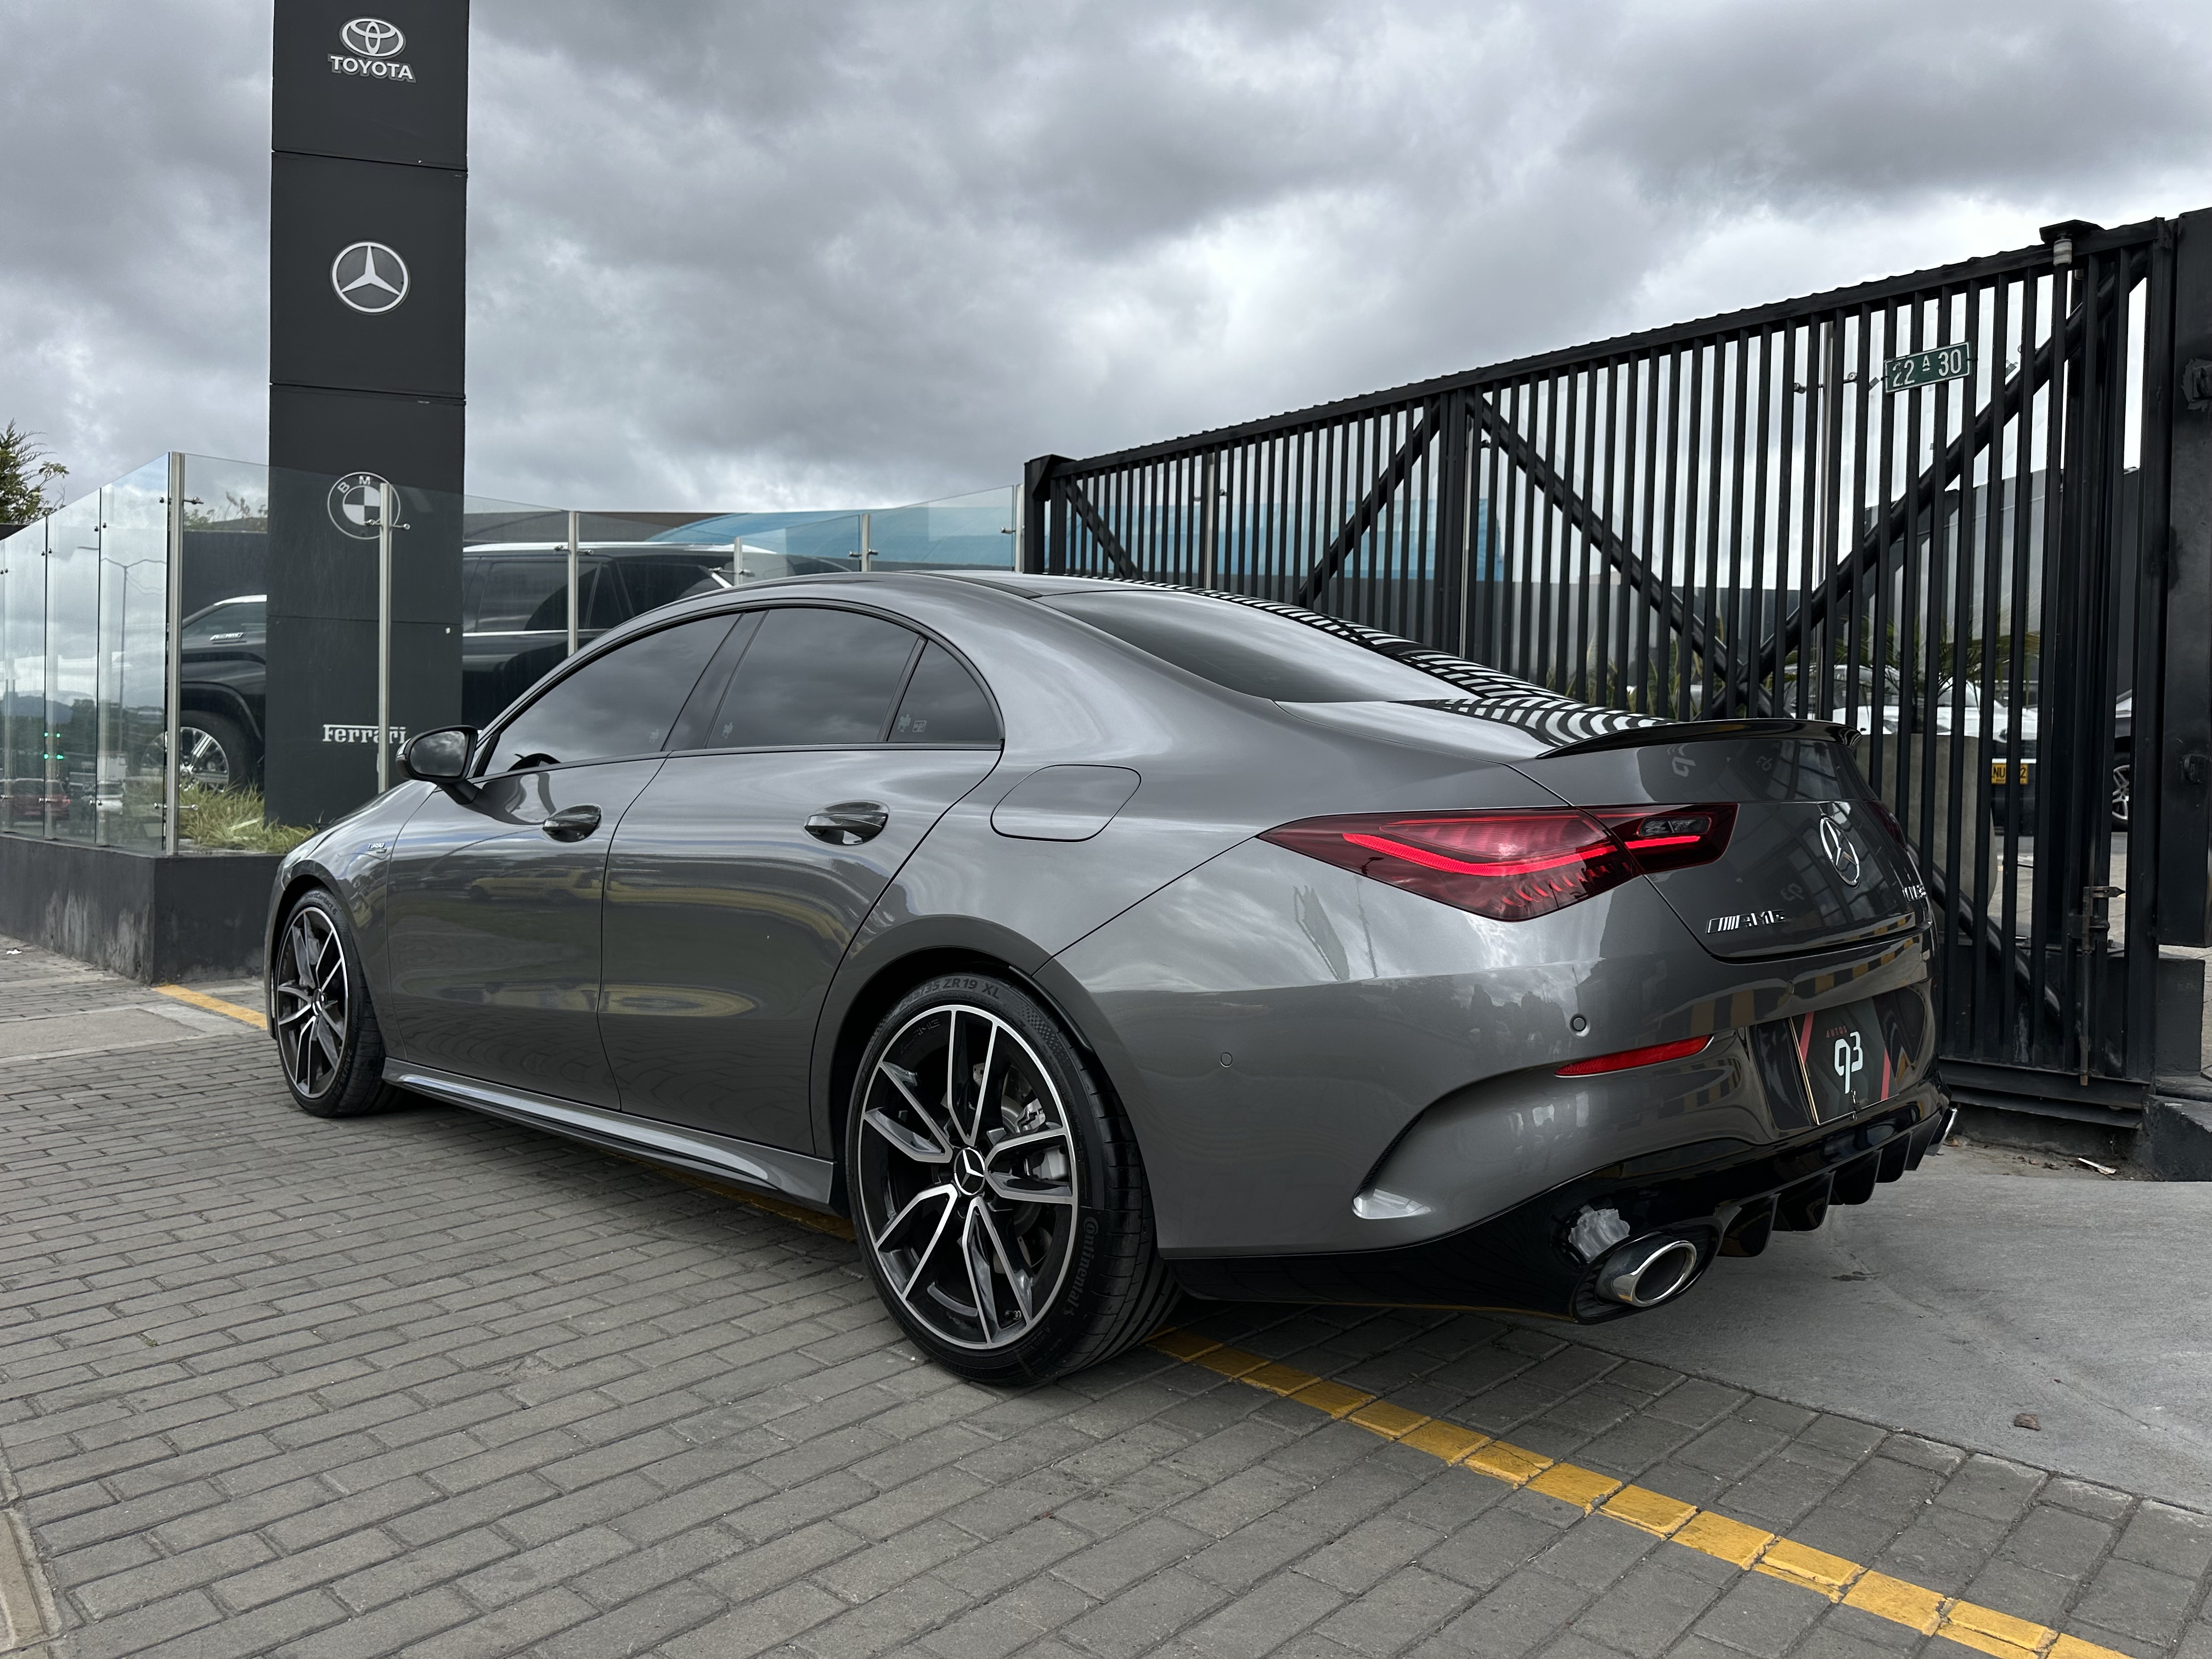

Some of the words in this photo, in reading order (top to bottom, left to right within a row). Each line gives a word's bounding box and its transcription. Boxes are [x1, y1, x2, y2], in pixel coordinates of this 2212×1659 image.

[330, 55, 413, 80] TOYOTA
[1893, 359, 1915, 387] 22
[1938, 349, 1962, 377] 30
[943, 978, 962, 988] ZR
[963, 979, 978, 989] 19
[982, 983, 1000, 999] XL
[1826, 1025, 1848, 1038] AUTOS
[1067, 1216, 1099, 1308] Continental
